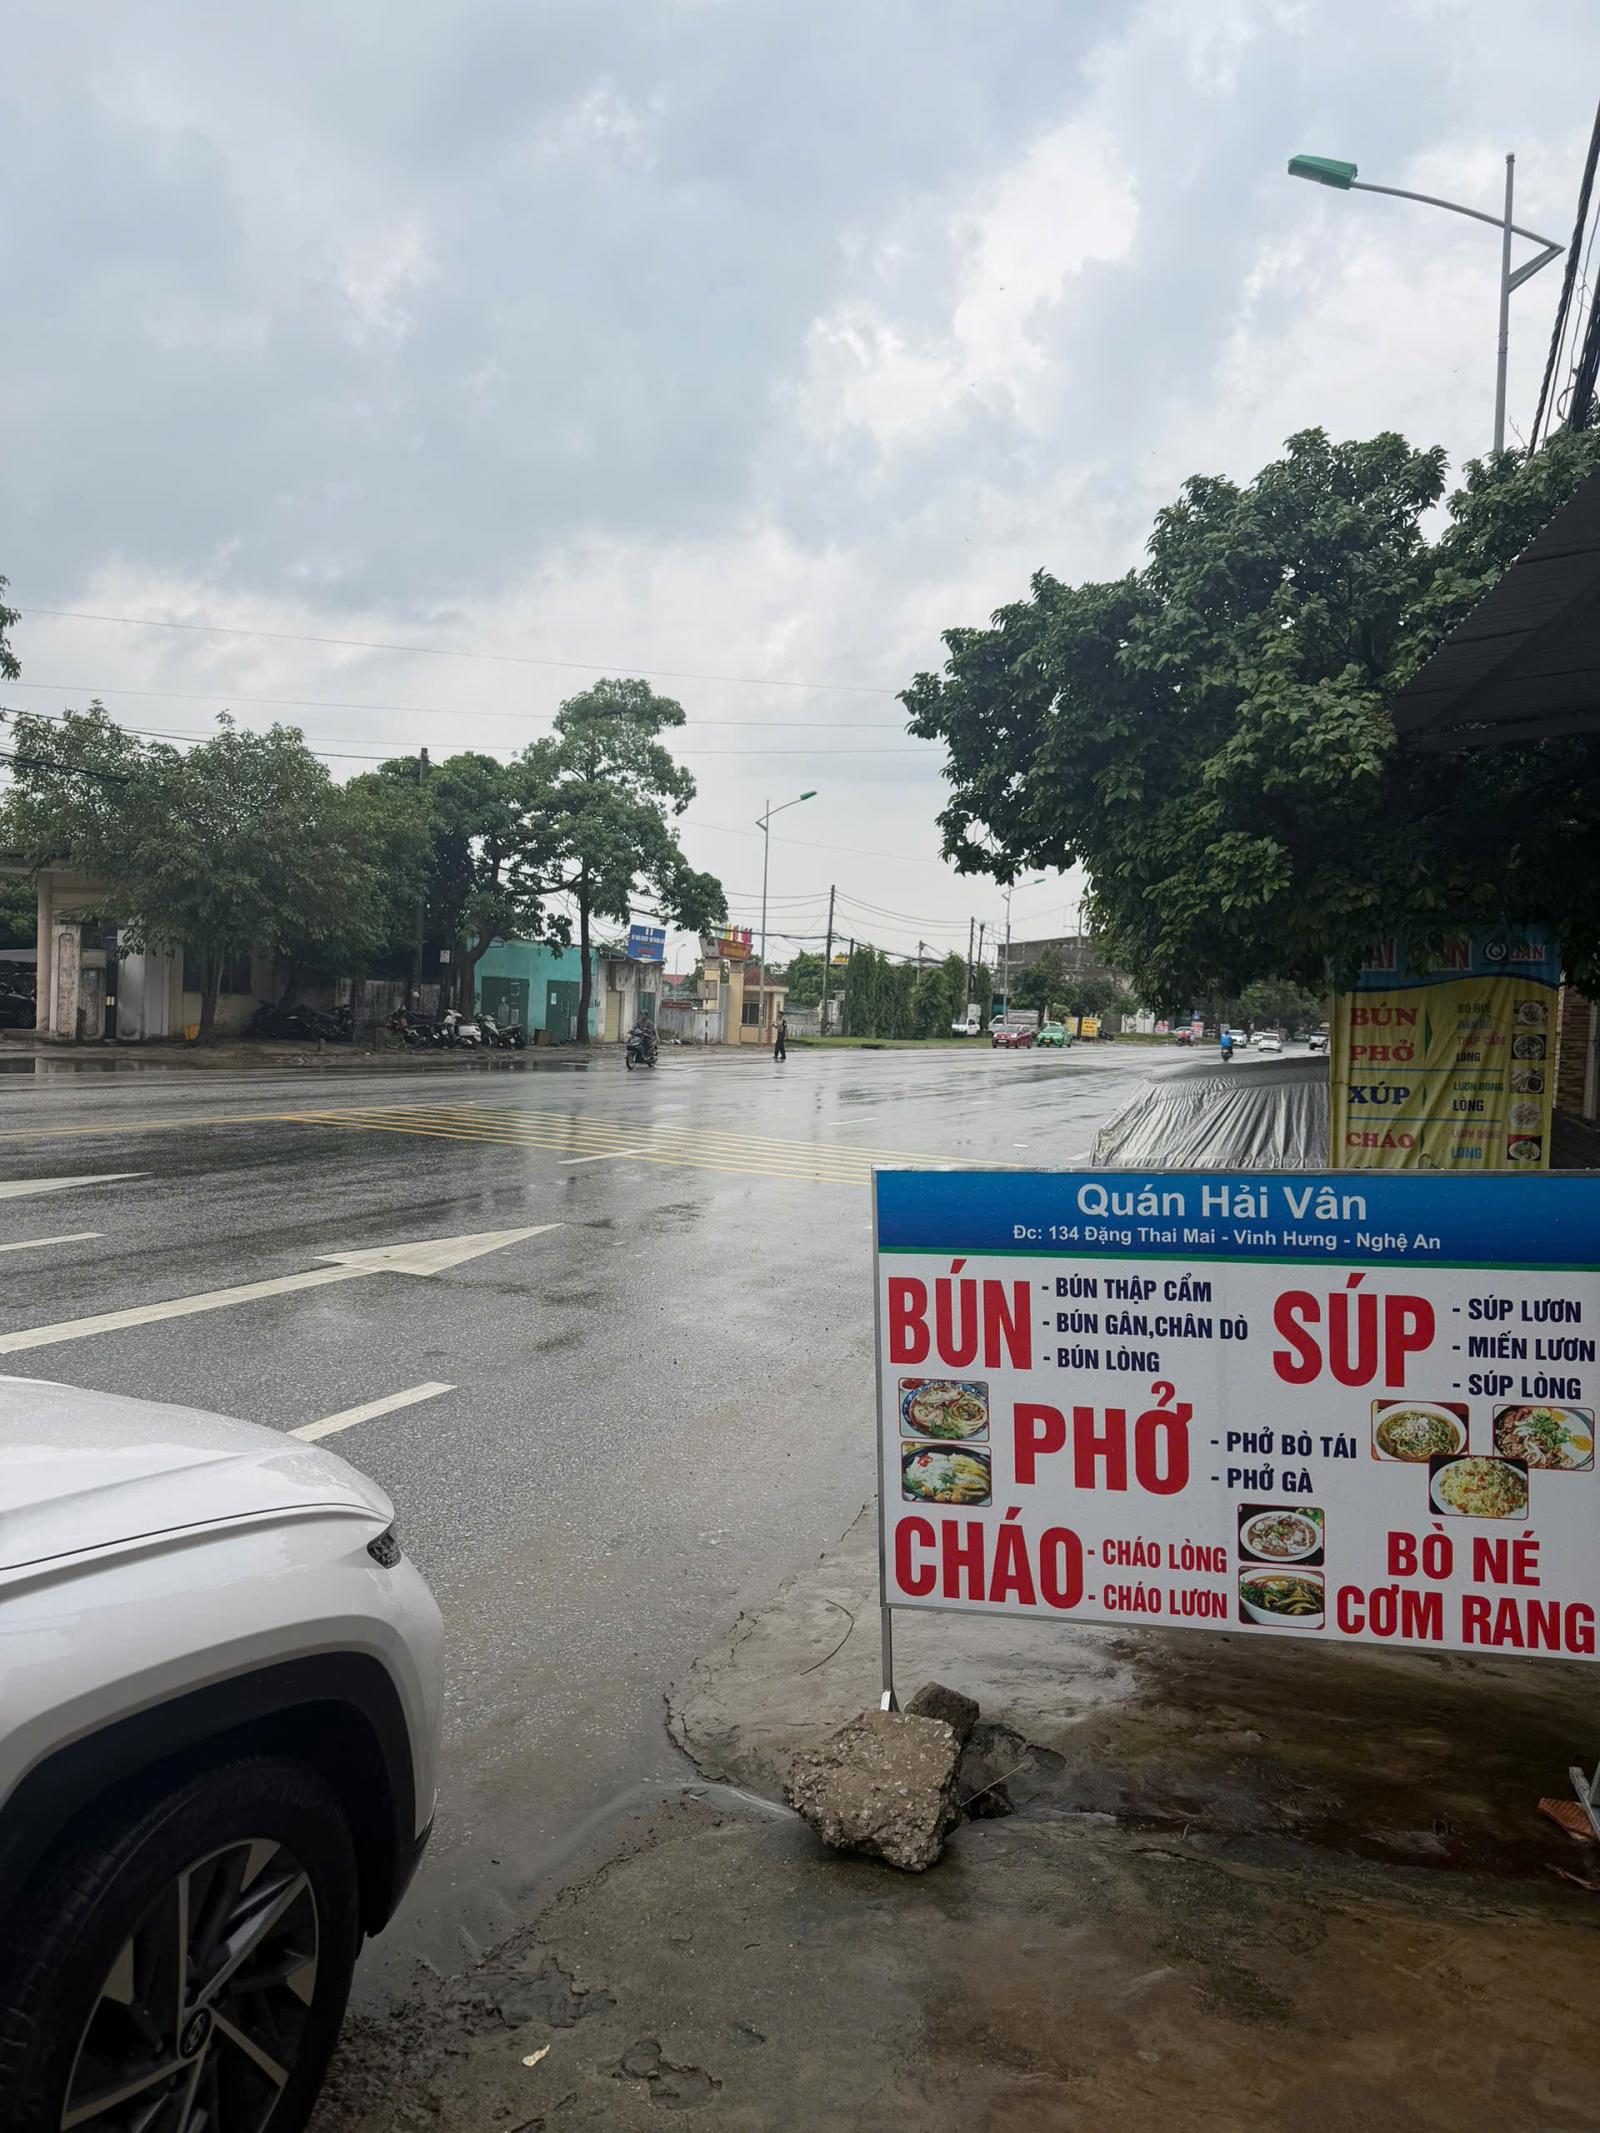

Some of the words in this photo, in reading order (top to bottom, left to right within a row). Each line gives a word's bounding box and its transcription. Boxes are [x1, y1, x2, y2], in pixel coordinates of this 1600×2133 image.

[1350, 1002, 1418, 1026] BÚN
[1350, 1039, 1415, 1062] PHỞ
[1348, 1081, 1411, 1105] XÚP
[1346, 1129, 1415, 1149] CHÁO
[1077, 1183, 1185, 1218] Quán
[1202, 1184, 1268, 1219] Hải
[1283, 1186, 1367, 1221] Vân
[1013, 1225, 1043, 1240] Đc:
[1048, 1226, 1079, 1241] 134
[1084, 1226, 1132, 1246] Đặng
[1138, 1227, 1177, 1243] Thai
[1183, 1228, 1216, 1245] Mai
[1233, 1229, 1277, 1246] Vinh
[1283, 1231, 1337, 1250] Hưng
[1356, 1232, 1407, 1252] Nghệ
[1413, 1234, 1441, 1250] An
[1056, 1274, 1097, 1299] BÚN
[1104, 1275, 1157, 1304] THẬP
[1164, 1272, 1212, 1302] CẨM
[888, 1259, 1032, 1370] BÚN
[1468, 1294, 1513, 1321] SÚP
[1521, 1299, 1582, 1323] LƯƠN
[1056, 1309, 1098, 1334] BÚN
[1219, 1315, 1248, 1341] DÒ
[1273, 1273, 1435, 1387] SÚP
[1057, 1344, 1099, 1370] BÚN
[1106, 1345, 1160, 1372] LÒNG
[1468, 1330, 1527, 1360] MIẾN
[1535, 1337, 1595, 1362] LƯƠN
[1468, 1370, 1513, 1397] SÚP
[1521, 1371, 1582, 1400] LÒNG
[1013, 1380, 1193, 1496] PHỞ
[1227, 1426, 1274, 1455] PHỞ
[1281, 1430, 1312, 1457] BÒ
[1320, 1432, 1357, 1459] TÁI
[1227, 1463, 1274, 1492] PHỞ
[1282, 1467, 1313, 1493] GÀ
[895, 1507, 1083, 1609] CHÁO
[1103, 1536, 1160, 1569] CHÁO
[1168, 1538, 1227, 1574] LÒNG
[1387, 1522, 1453, 1580] BÒ
[1473, 1530, 1540, 1587] NÉ
[1103, 1581, 1161, 1613] CHÁO
[1169, 1586, 1227, 1619] LƯƠN
[1337, 1584, 1443, 1641] CƠM
[1462, 1594, 1595, 1654] RANG
